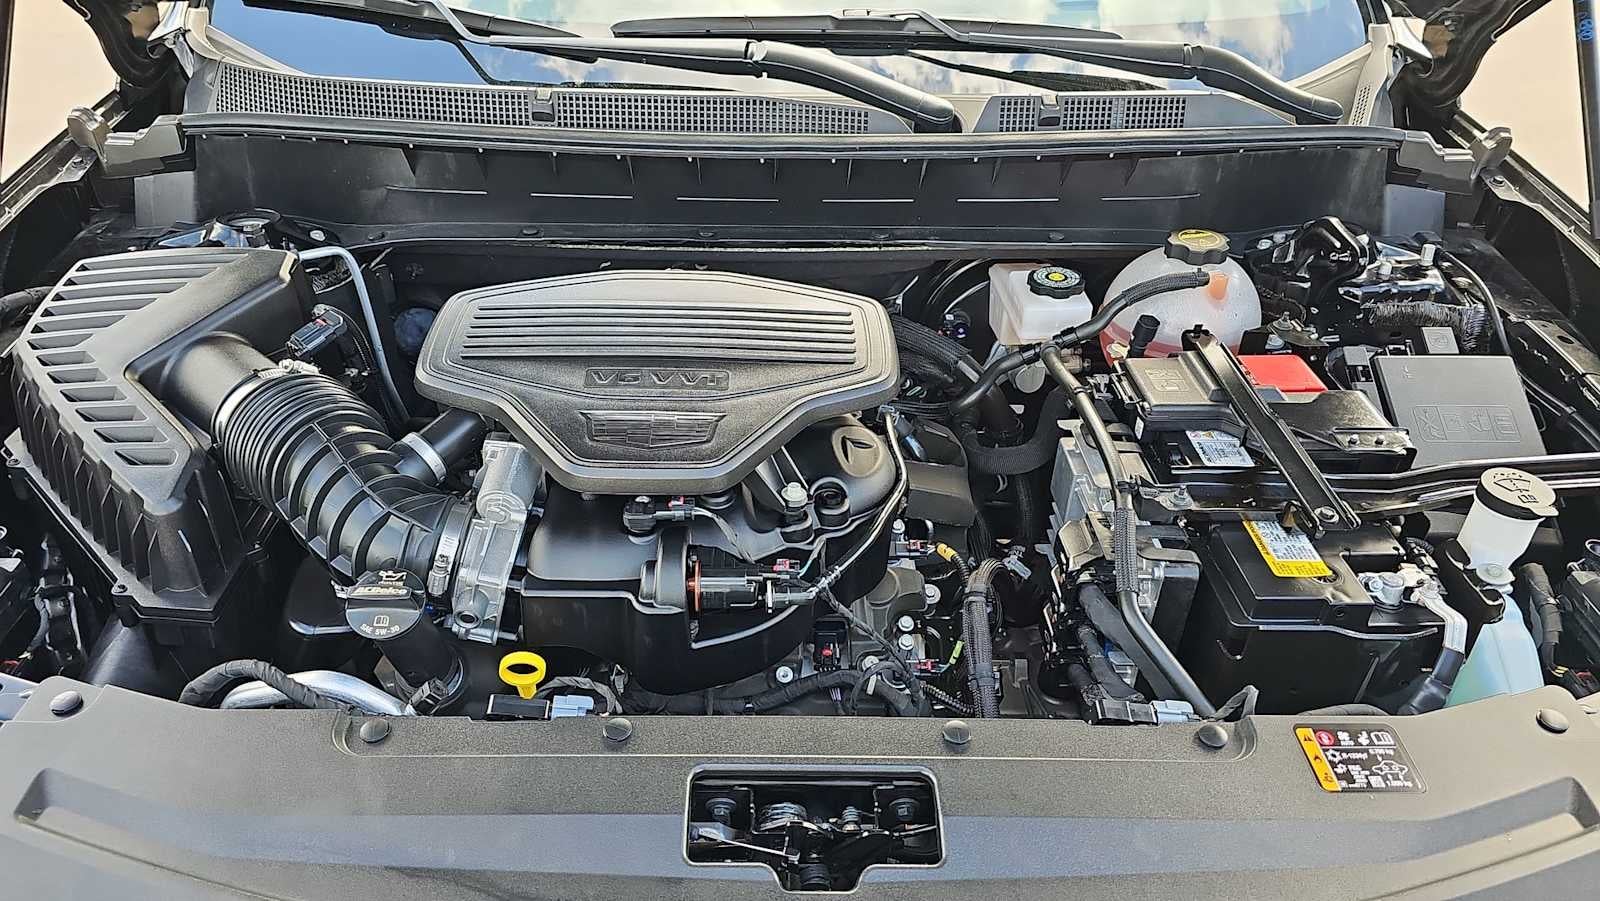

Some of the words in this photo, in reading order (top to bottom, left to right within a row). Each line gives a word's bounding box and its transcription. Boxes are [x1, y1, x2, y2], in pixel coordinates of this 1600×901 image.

[650, 371, 724, 386] VVT
[360, 623, 373, 634] SAE
[375, 625, 400, 635] 5W-30
